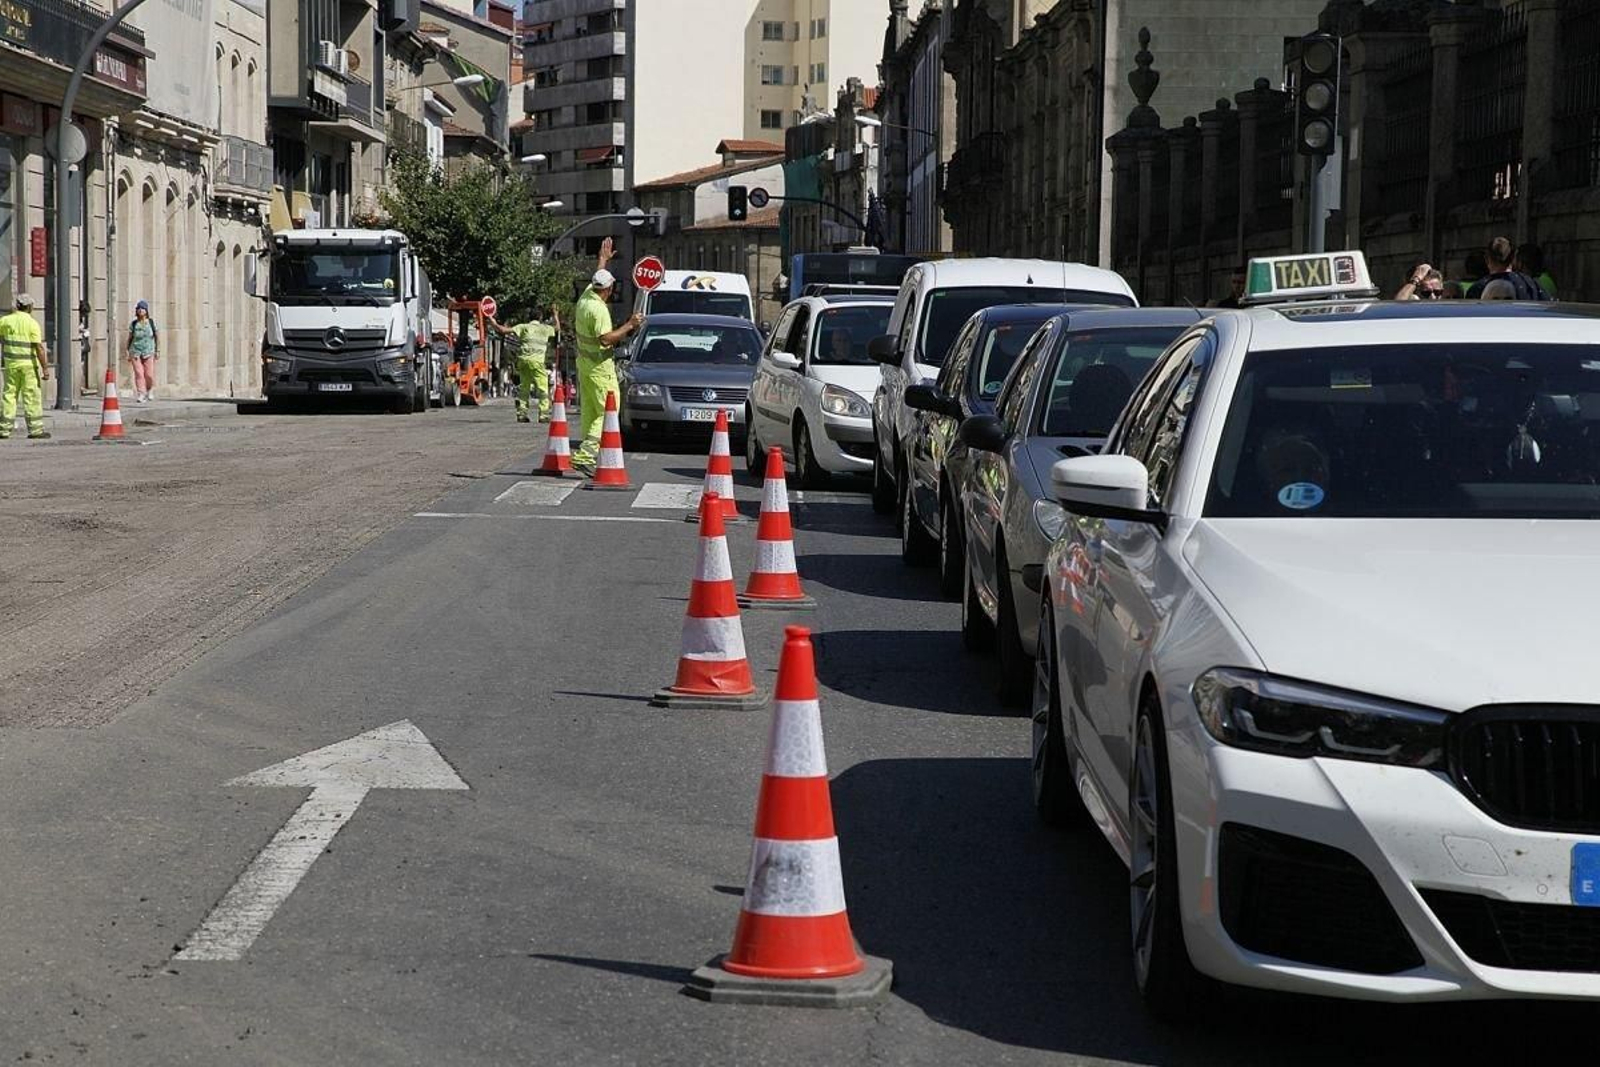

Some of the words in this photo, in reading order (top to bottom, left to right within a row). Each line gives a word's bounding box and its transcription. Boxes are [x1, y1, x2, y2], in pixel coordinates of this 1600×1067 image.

[637, 267, 661, 279] STOP
[1276, 259, 1331, 288] TAXI
[689, 410, 713, 420] 1209
[1582, 879, 1594, 893] E
